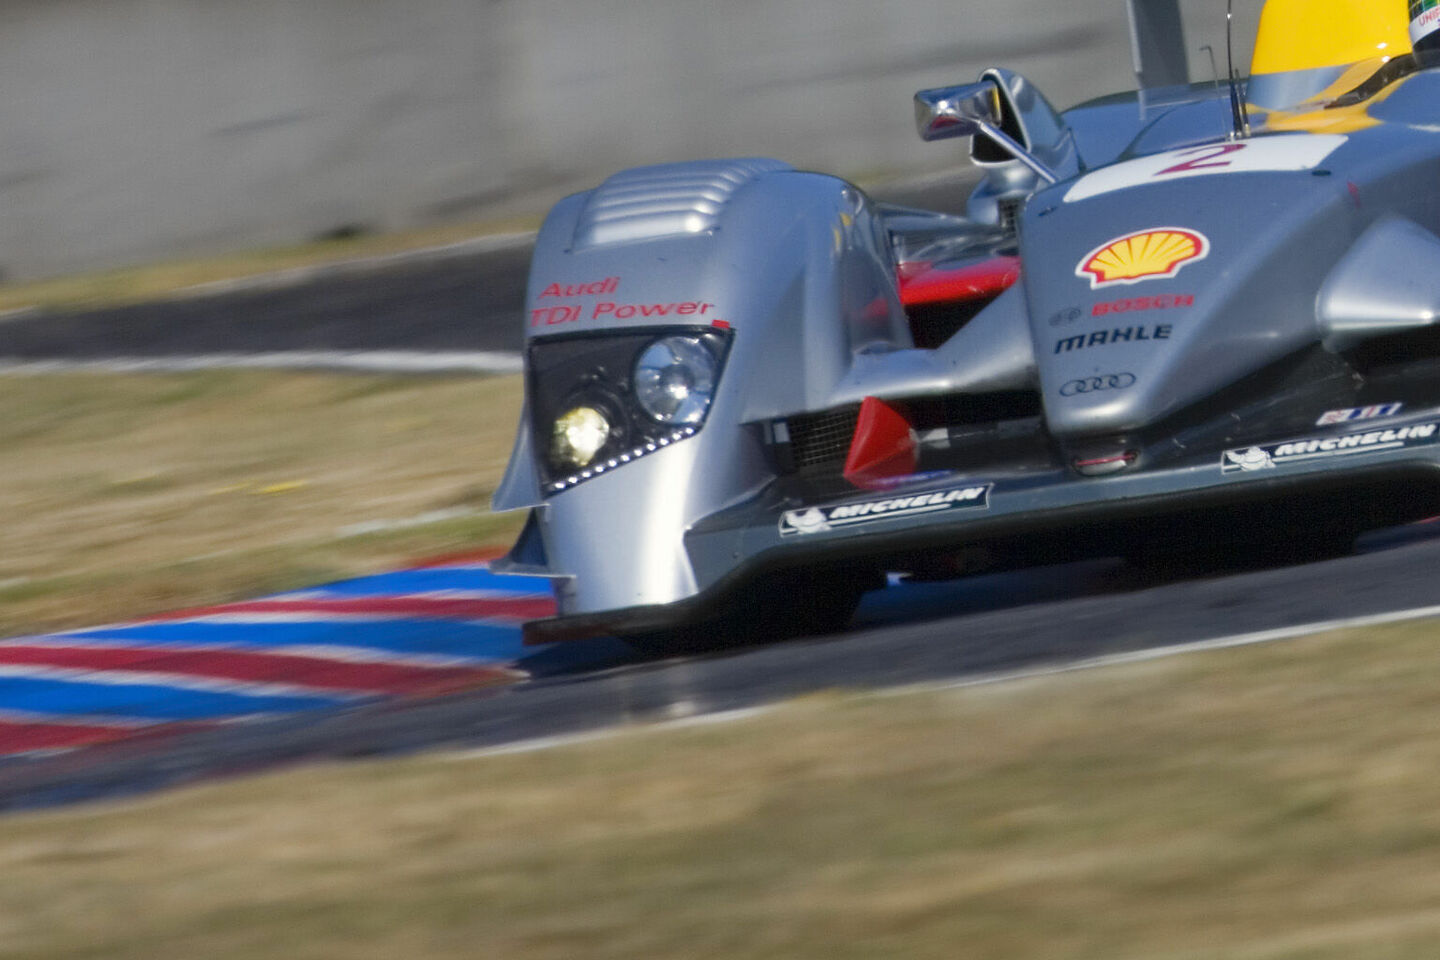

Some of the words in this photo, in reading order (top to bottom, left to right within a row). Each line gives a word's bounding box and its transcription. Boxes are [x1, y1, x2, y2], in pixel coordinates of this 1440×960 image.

[1152, 143, 1248, 177] 2
[538, 276, 621, 299] Audi
[530, 304, 583, 327] TDI
[592, 300, 715, 321] Power
[1091, 293, 1195, 317] BOSCH
[1053, 323, 1173, 355] MAHLE
[1273, 422, 1437, 457] MICHELIN
[828, 485, 986, 520] MICHELIN
